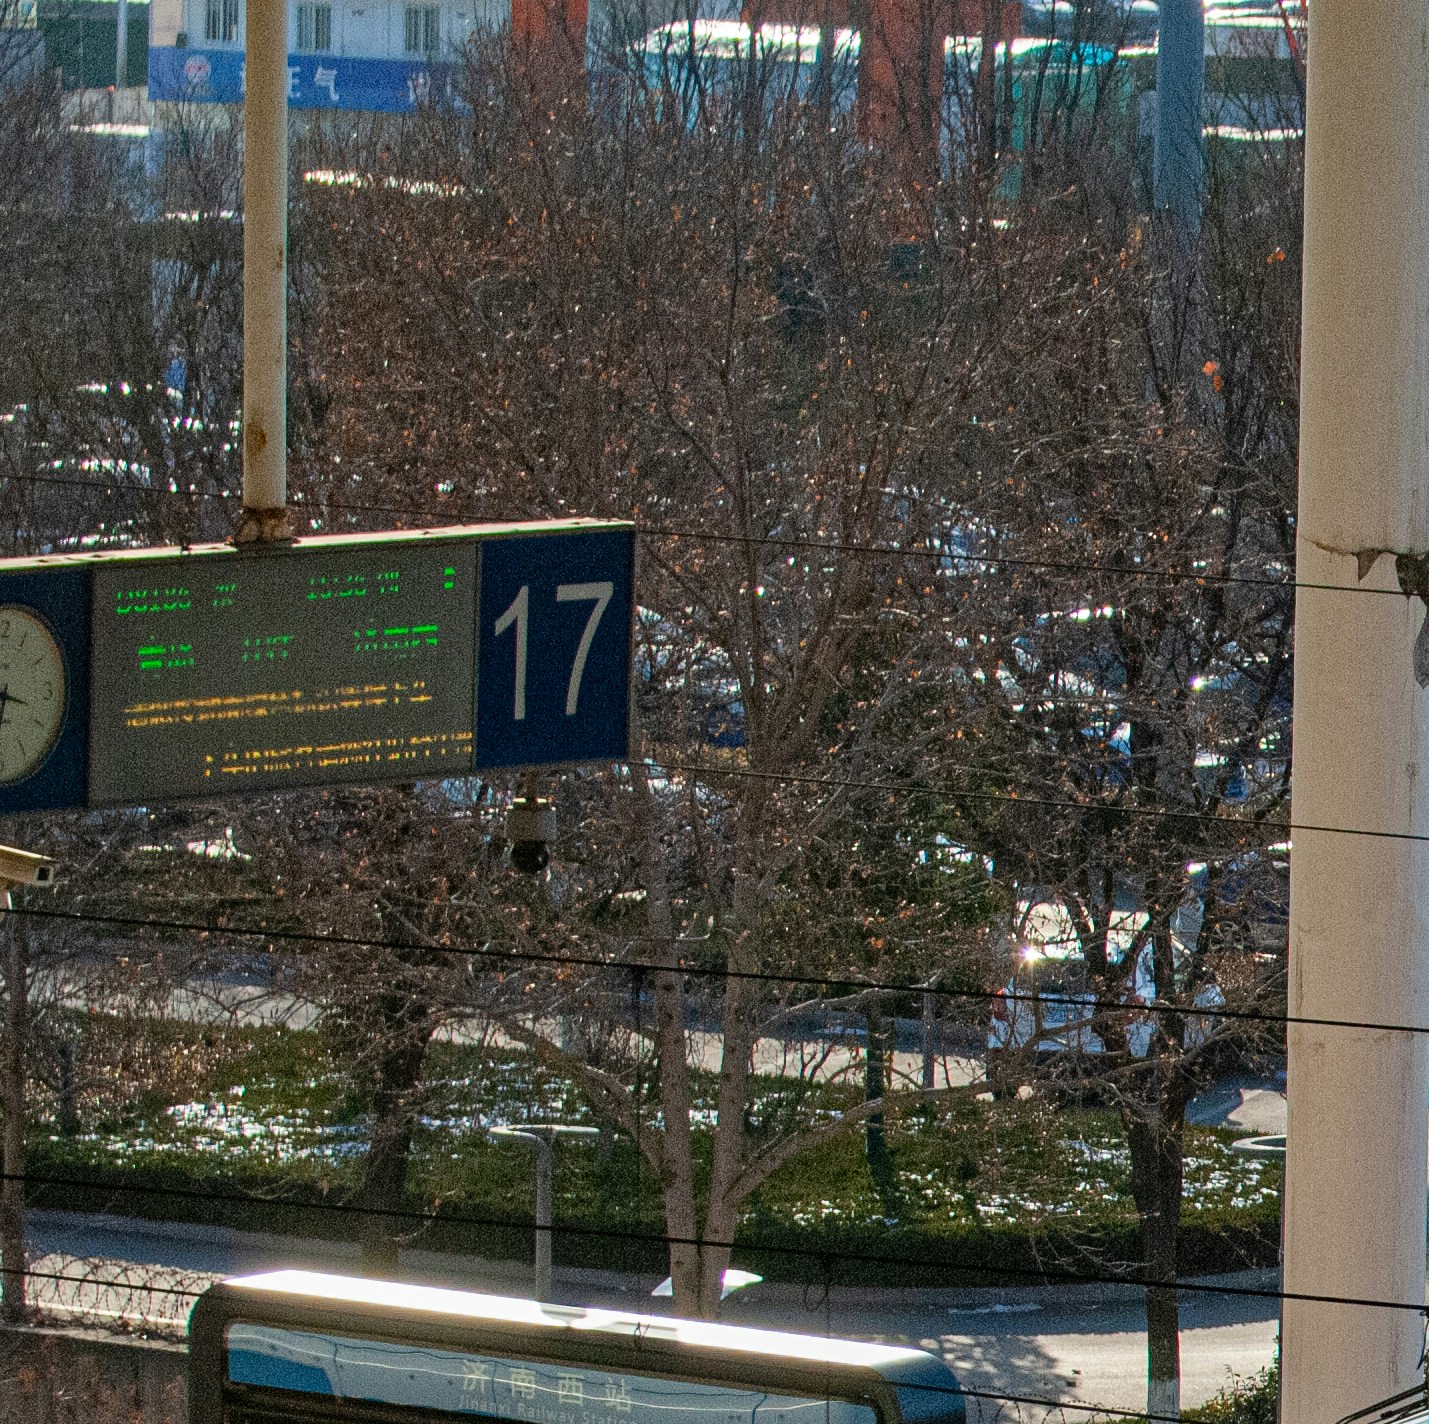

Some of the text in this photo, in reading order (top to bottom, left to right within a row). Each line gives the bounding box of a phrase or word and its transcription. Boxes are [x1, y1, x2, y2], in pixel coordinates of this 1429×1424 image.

[494, 580, 614, 720] 17
[458, 1394, 511, 1414] Jinanxi
[517, 1403, 575, 1424] Railway
[462, 1359, 632, 1413] 济南西站
